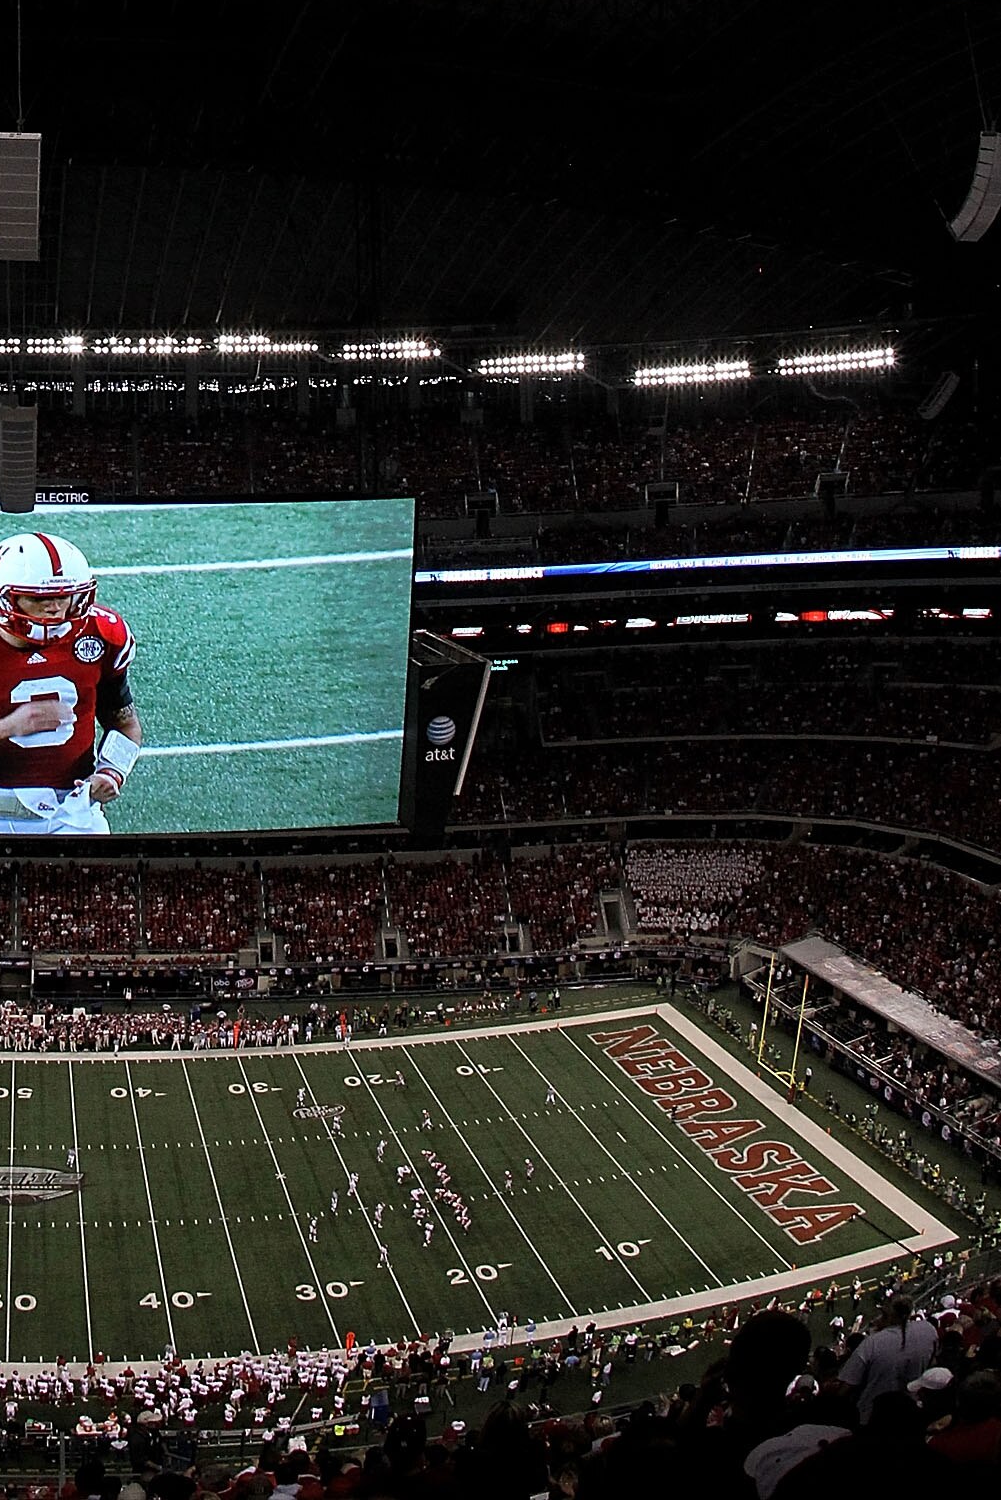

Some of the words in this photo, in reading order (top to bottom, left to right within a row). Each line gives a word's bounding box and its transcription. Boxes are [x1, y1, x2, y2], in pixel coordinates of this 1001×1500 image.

[35, 492, 90, 503] ELECTRIC
[442, 570, 488, 581] FARMERS
[489, 568, 543, 580] INSURANCE
[425, 746, 456, 762] at&t
[587, 1024, 867, 1246] NEBRASKA
[594, 1241, 641, 1261] 10
[446, 1264, 499, 1286] 20
[139, 1291, 195, 1309] 40
[295, 1281, 350, 1301] 30
